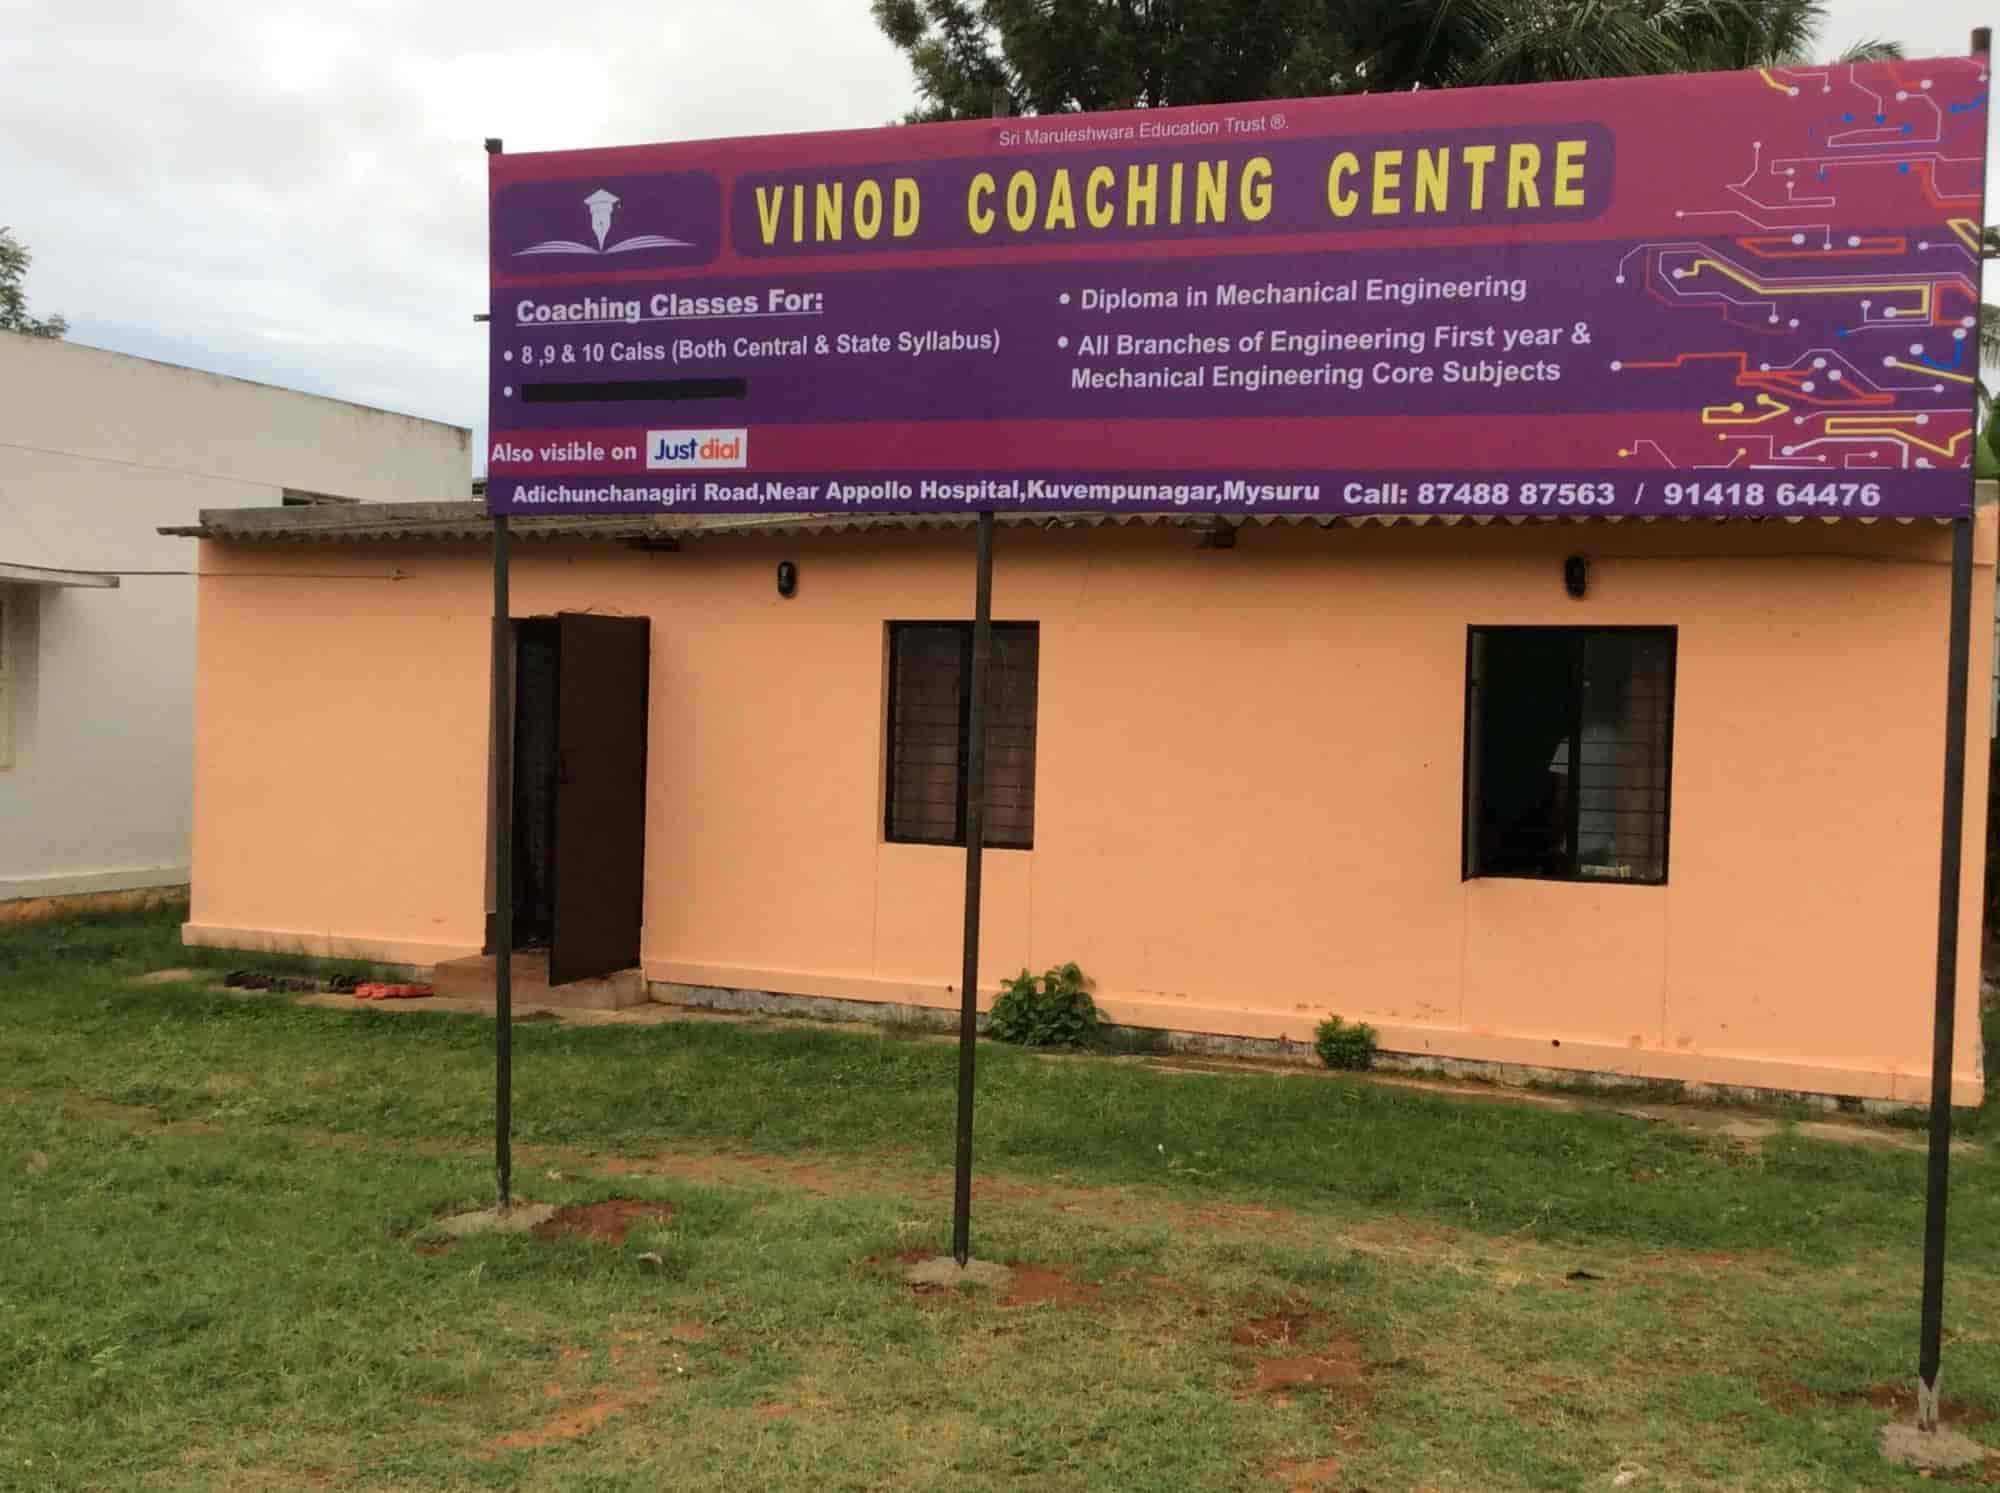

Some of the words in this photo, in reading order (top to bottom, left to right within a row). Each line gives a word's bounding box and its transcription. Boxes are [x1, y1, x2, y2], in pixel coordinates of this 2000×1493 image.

[999, 131, 1020, 146] Sri
[1025, 125, 1135, 146] Maruleshwara
[1139, 120, 1219, 138] Education
[1223, 115, 1266, 133] Trust
[755, 178, 920, 244] VINOD
[967, 156, 1274, 234] COACHING
[1327, 140, 1587, 217] CENTRE
[516, 297, 641, 324] Coaching
[650, 293, 759, 317] Classes
[768, 288, 823, 312] For:
[1081, 288, 1179, 313] Diploma
[1186, 287, 1208, 307] in
[1216, 280, 1358, 306] Mechanical
[1366, 276, 1527, 305] Engineering
[561, 344, 577, 363] &
[582, 343, 605, 362] 10
[610, 341, 666, 362] Calss
[671, 339, 727, 364] (Both
[733, 336, 808, 358] Central
[814, 334, 830, 355] &
[836, 333, 891, 354] State
[897, 328, 1000, 357] Syllabus)
[1077, 335, 1109, 356] All
[1116, 332, 1231, 356] Branches
[1238, 331, 1265, 353] of
[1271, 327, 1425, 357] Engineering
[1434, 325, 1496, 348] First
[1503, 328, 1564, 352] year
[1570, 322, 1591, 345] &
[1071, 366, 1205, 389] Mechanical
[1212, 364, 1364, 392] Engineering
[1372, 361, 1434, 384] Core
[1442, 359, 1561, 388] Subjects
[491, 443, 534, 462] Also
[539, 442, 605, 462] visible
[611, 446, 637, 461] on
[512, 484, 697, 506] Adichunchanagiri
[825, 481, 913, 504] Appollo
[1343, 482, 1408, 505] Call:
[1417, 483, 1510, 505] 87488
[1519, 482, 1615, 505] 87563
[1634, 482, 1645, 505] /
[1663, 482, 1765, 506] 91418
[1775, 482, 1881, 507] 64476
